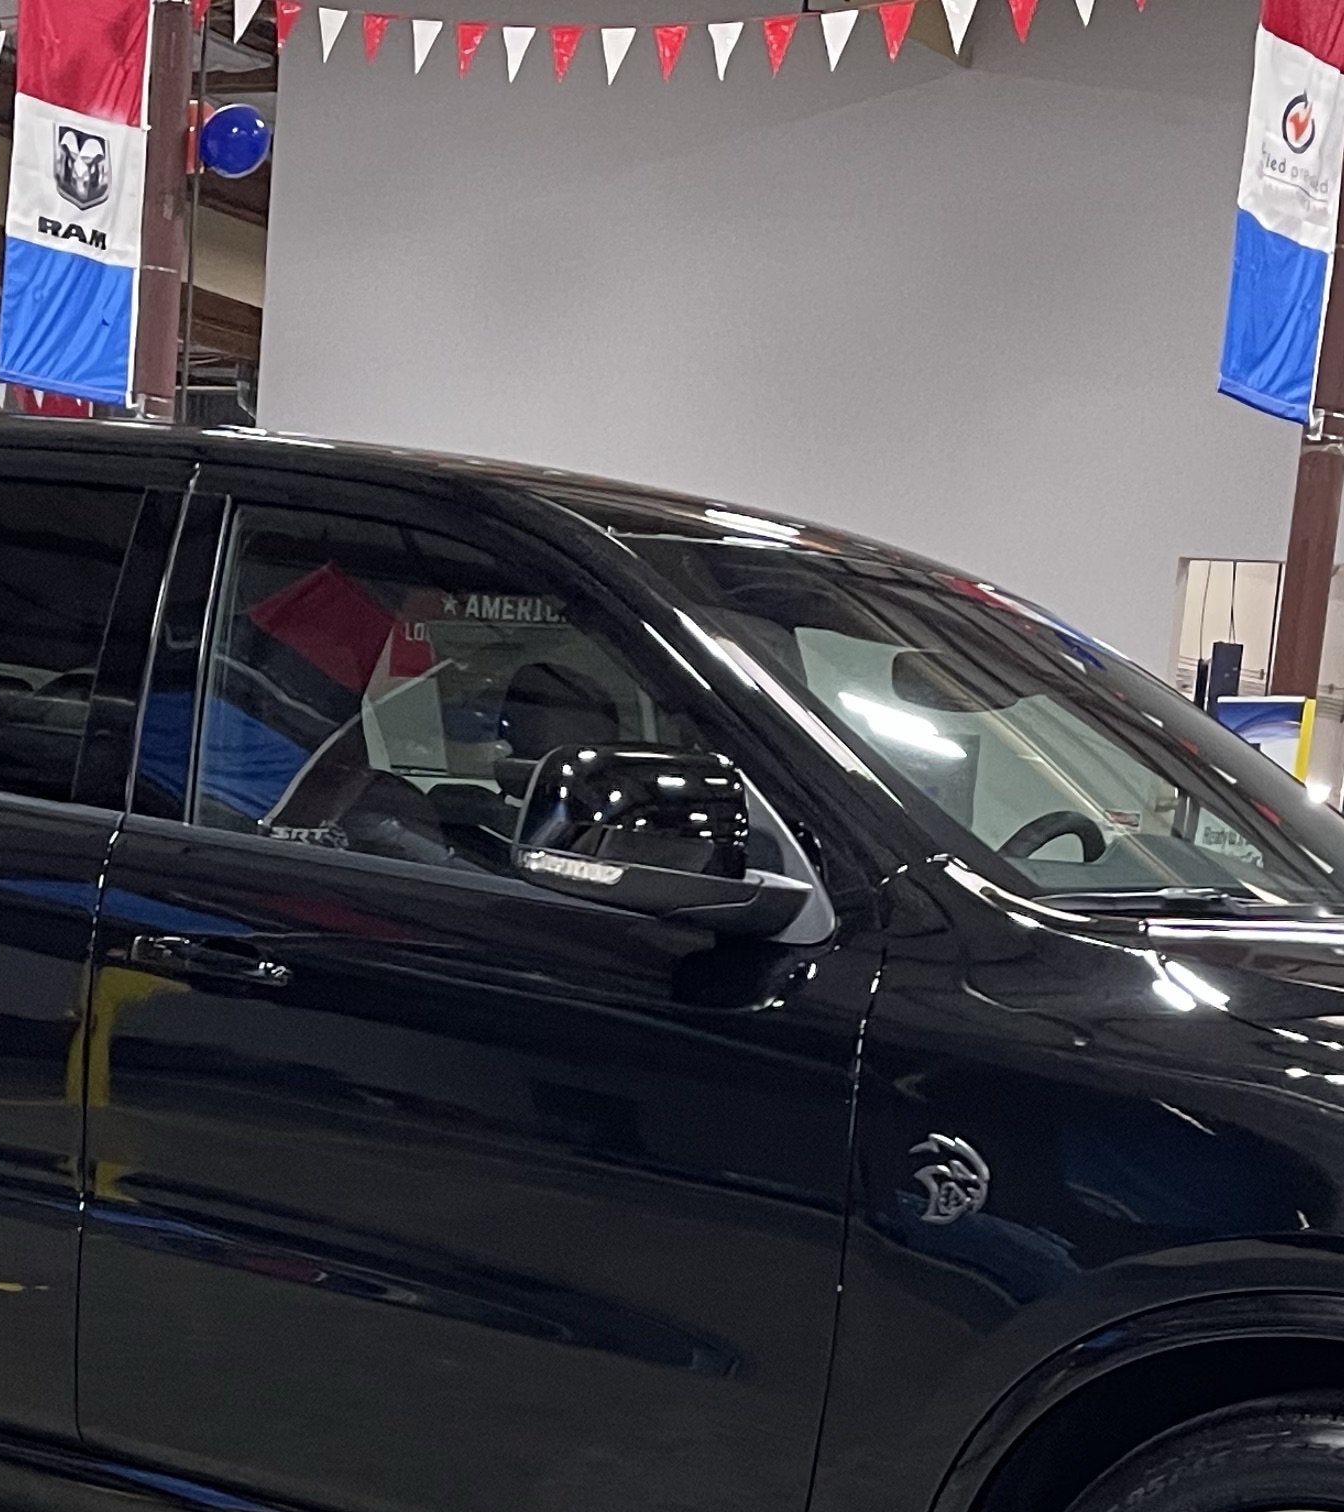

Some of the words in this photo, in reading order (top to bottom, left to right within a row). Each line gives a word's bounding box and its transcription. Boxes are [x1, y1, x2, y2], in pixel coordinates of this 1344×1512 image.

[38, 216, 107, 251] RAM
[464, 595, 568, 623] AMERIC
[270, 826, 330, 845] SRT
